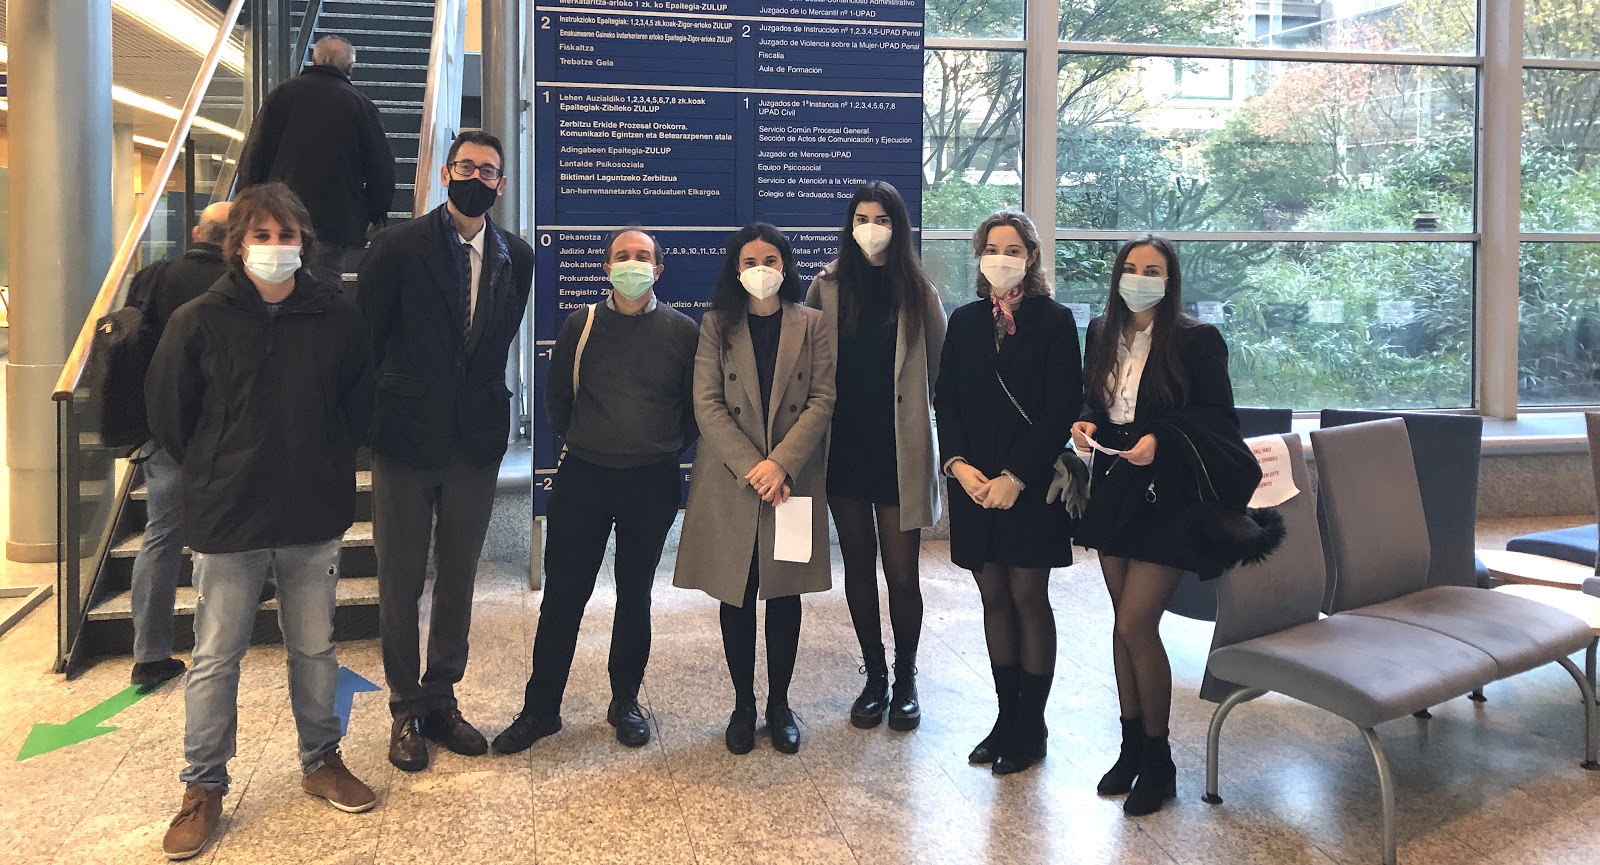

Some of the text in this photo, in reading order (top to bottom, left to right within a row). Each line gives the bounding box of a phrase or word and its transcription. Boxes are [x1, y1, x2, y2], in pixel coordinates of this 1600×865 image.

[760, 7, 788, 15] Juzgado
[809, 8, 838, 16] Mercantil
[541, 16, 550, 29] 2
[631, 19, 653, 27] 1,2,3,4,5
[742, 25, 750, 38] 2
[759, 24, 792, 33] Juzgados
[804, 26, 839, 34] Instrucción
[850, 28, 900, 36] 1,2,3,4,5-UPAD
[759, 39, 788, 47] Juzgado
[860, 42, 899, 50] Mujer-UPAD
[560, 58, 593, 66] Trebatze
[788, 66, 822, 74] Formación
[543, 91, 550, 103] 1
[627, 96, 676, 104] 1,2,3,4,5,6,7,8
[744, 97, 749, 109] 1
[560, 120, 591, 128] Zerbitzu
[593, 121, 617, 129] Erkide
[788, 126, 811, 134] Común
[561, 130, 609, 138] Komunikazio
[612, 131, 643, 139] Egintzen
[659, 132, 712, 141] Betearazpenen
[881, 136, 912, 144] Ejecución
[561, 146, 671, 155] Adingabeen Epaitegia-ZULUP
[758, 164, 781, 172] Equipo
[597, 174, 640, 182] Laguntzeko
[561, 187, 641, 195] Lan-harremanetarako
[759, 191, 784, 199] Colegio
[540, 234, 551, 246] 0
[560, 289, 598, 297] Erregistro
[536, 478, 553, 490] -2
